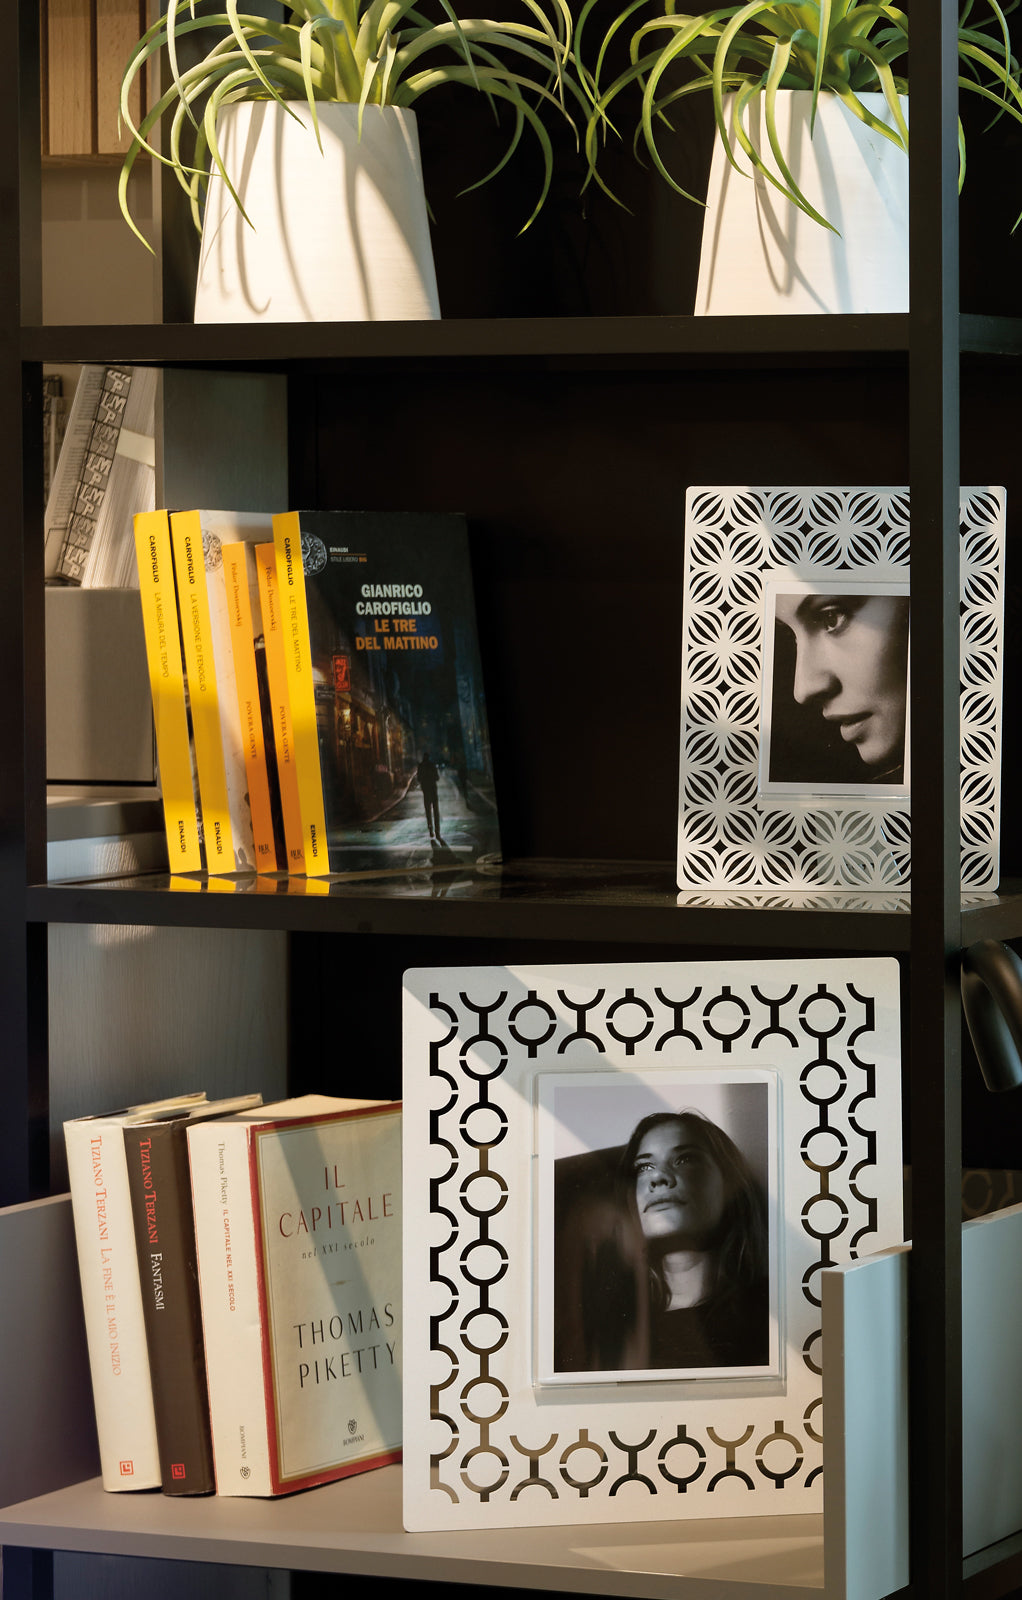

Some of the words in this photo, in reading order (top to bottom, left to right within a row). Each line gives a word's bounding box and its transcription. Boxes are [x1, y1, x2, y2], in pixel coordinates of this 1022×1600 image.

[149, 535, 160, 583] CAROFIGLIO
[184, 536, 196, 585] CAROFIGLIO
[284, 537, 294, 586] CAROFIGLIO
[361, 584, 423, 598] GIANRICO
[290, 606, 298, 620] TRE
[356, 602, 432, 616] CAROFIGLIO
[291, 621, 299, 637] DEL
[374, 619, 391, 633] LE
[393, 619, 417, 632] TRE
[293, 638, 302, 673] MATTINO
[355, 636, 381, 650] DEL
[384, 636, 438, 650] MATTINO
[249, 733, 257, 759] GENTE
[282, 738, 290, 763] GENTE
[178, 820, 187, 853] EINAUDI
[214, 821, 223, 855] EINAUDI
[310, 824, 318, 858] EINAUDI
[90, 1135, 104, 1187] TIZIANO
[140, 1138, 153, 1190] TIZIANO
[218, 1142, 226, 1175] Thomas
[220, 1177, 228, 1205] Piketty
[324, 1165, 345, 1190] IL
[95, 1188, 109, 1241] TERZANI
[145, 1191, 158, 1244] TERZANI
[223, 1208, 229, 1216] IL
[279, 1193, 394, 1238] CAPITALE
[223, 1217, 232, 1251] CAPITALE
[301, 1247, 318, 1260] nel
[321, 1242, 338, 1255] XXI
[343, 1236, 375, 1251] secolo
[101, 1247, 113, 1264] LA
[102, 1268, 113, 1291] FINE
[150, 1252, 165, 1310] FANTASMI
[106, 1304, 116, 1314] IL
[228, 1283, 236, 1312] SECOLO
[108, 1317, 118, 1340] MIO
[293, 1302, 394, 1348] THOMAS
[110, 1343, 122, 1377] INIZIO
[299, 1340, 396, 1388] PIKETTY
